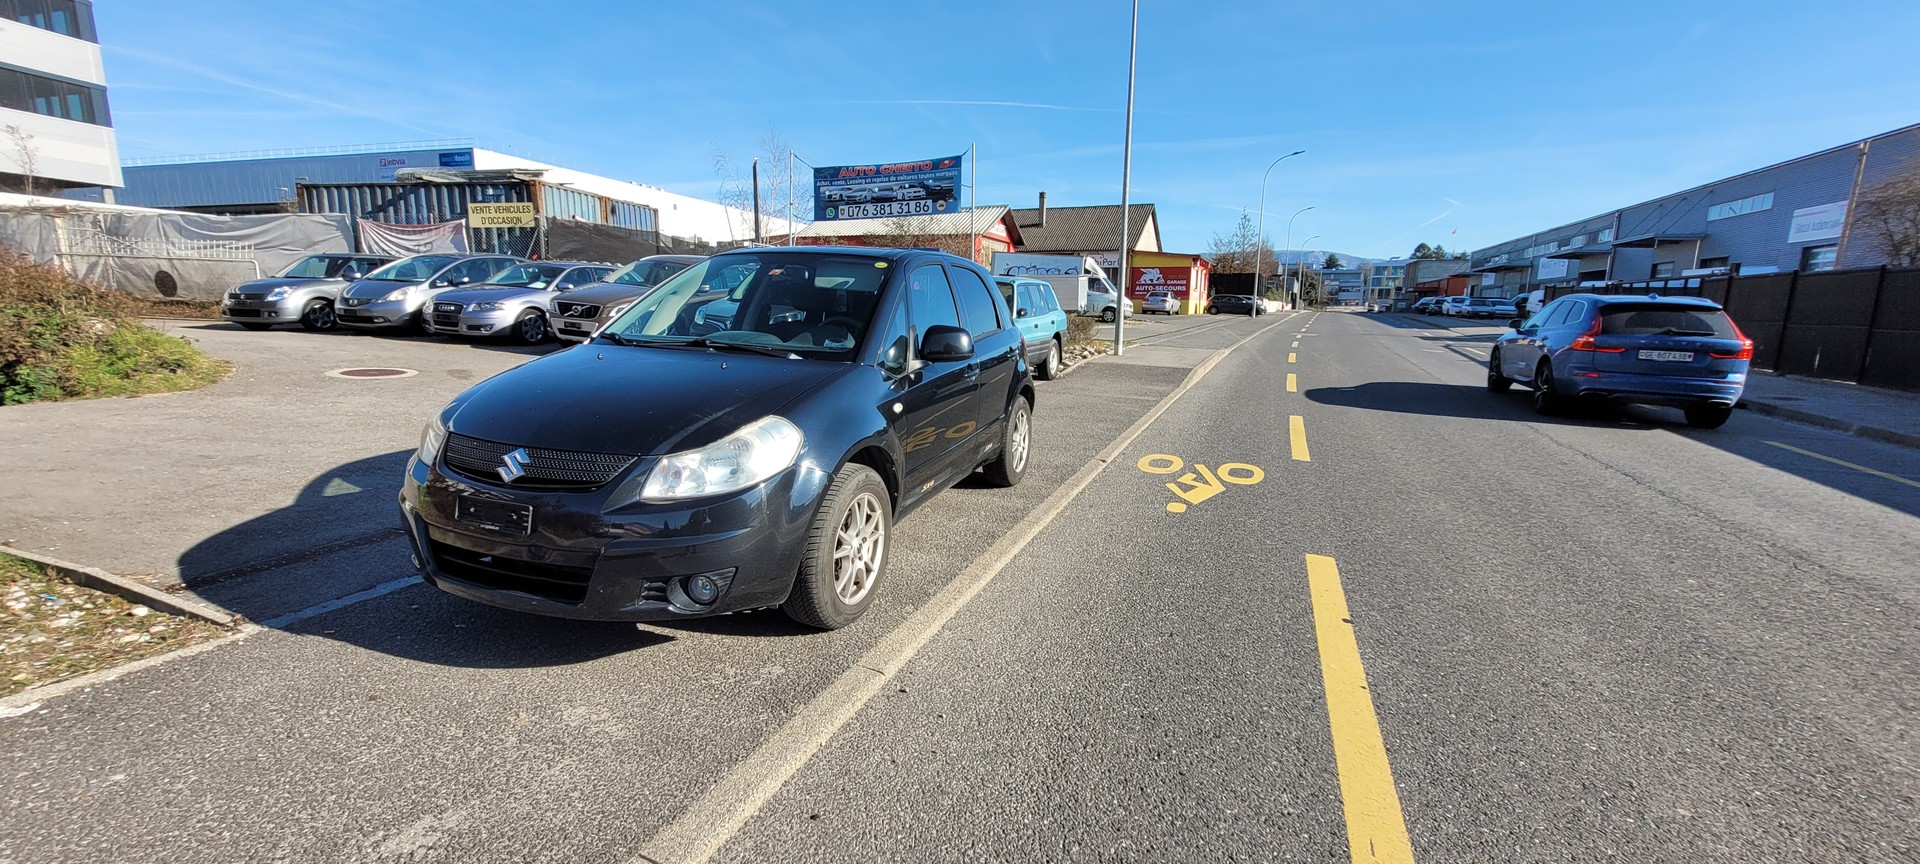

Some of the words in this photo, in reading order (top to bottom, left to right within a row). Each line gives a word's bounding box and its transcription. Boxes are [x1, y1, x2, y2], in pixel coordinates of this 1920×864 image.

[838, 165, 877, 178] AUTO
[880, 160, 932, 174] CHEITO
[872, 175, 889, 183] reprise
[897, 172, 918, 180] voitures
[919, 171, 935, 179] toutes
[936, 170, 958, 178] marques
[470, 205, 493, 214] VENTE
[493, 205, 531, 214] VEHICULES
[847, 205, 869, 218] 076
[871, 203, 894, 216] 381
[896, 202, 912, 214] 31
[914, 201, 930, 213] 86
[481, 216, 523, 225] D'OCCASION
